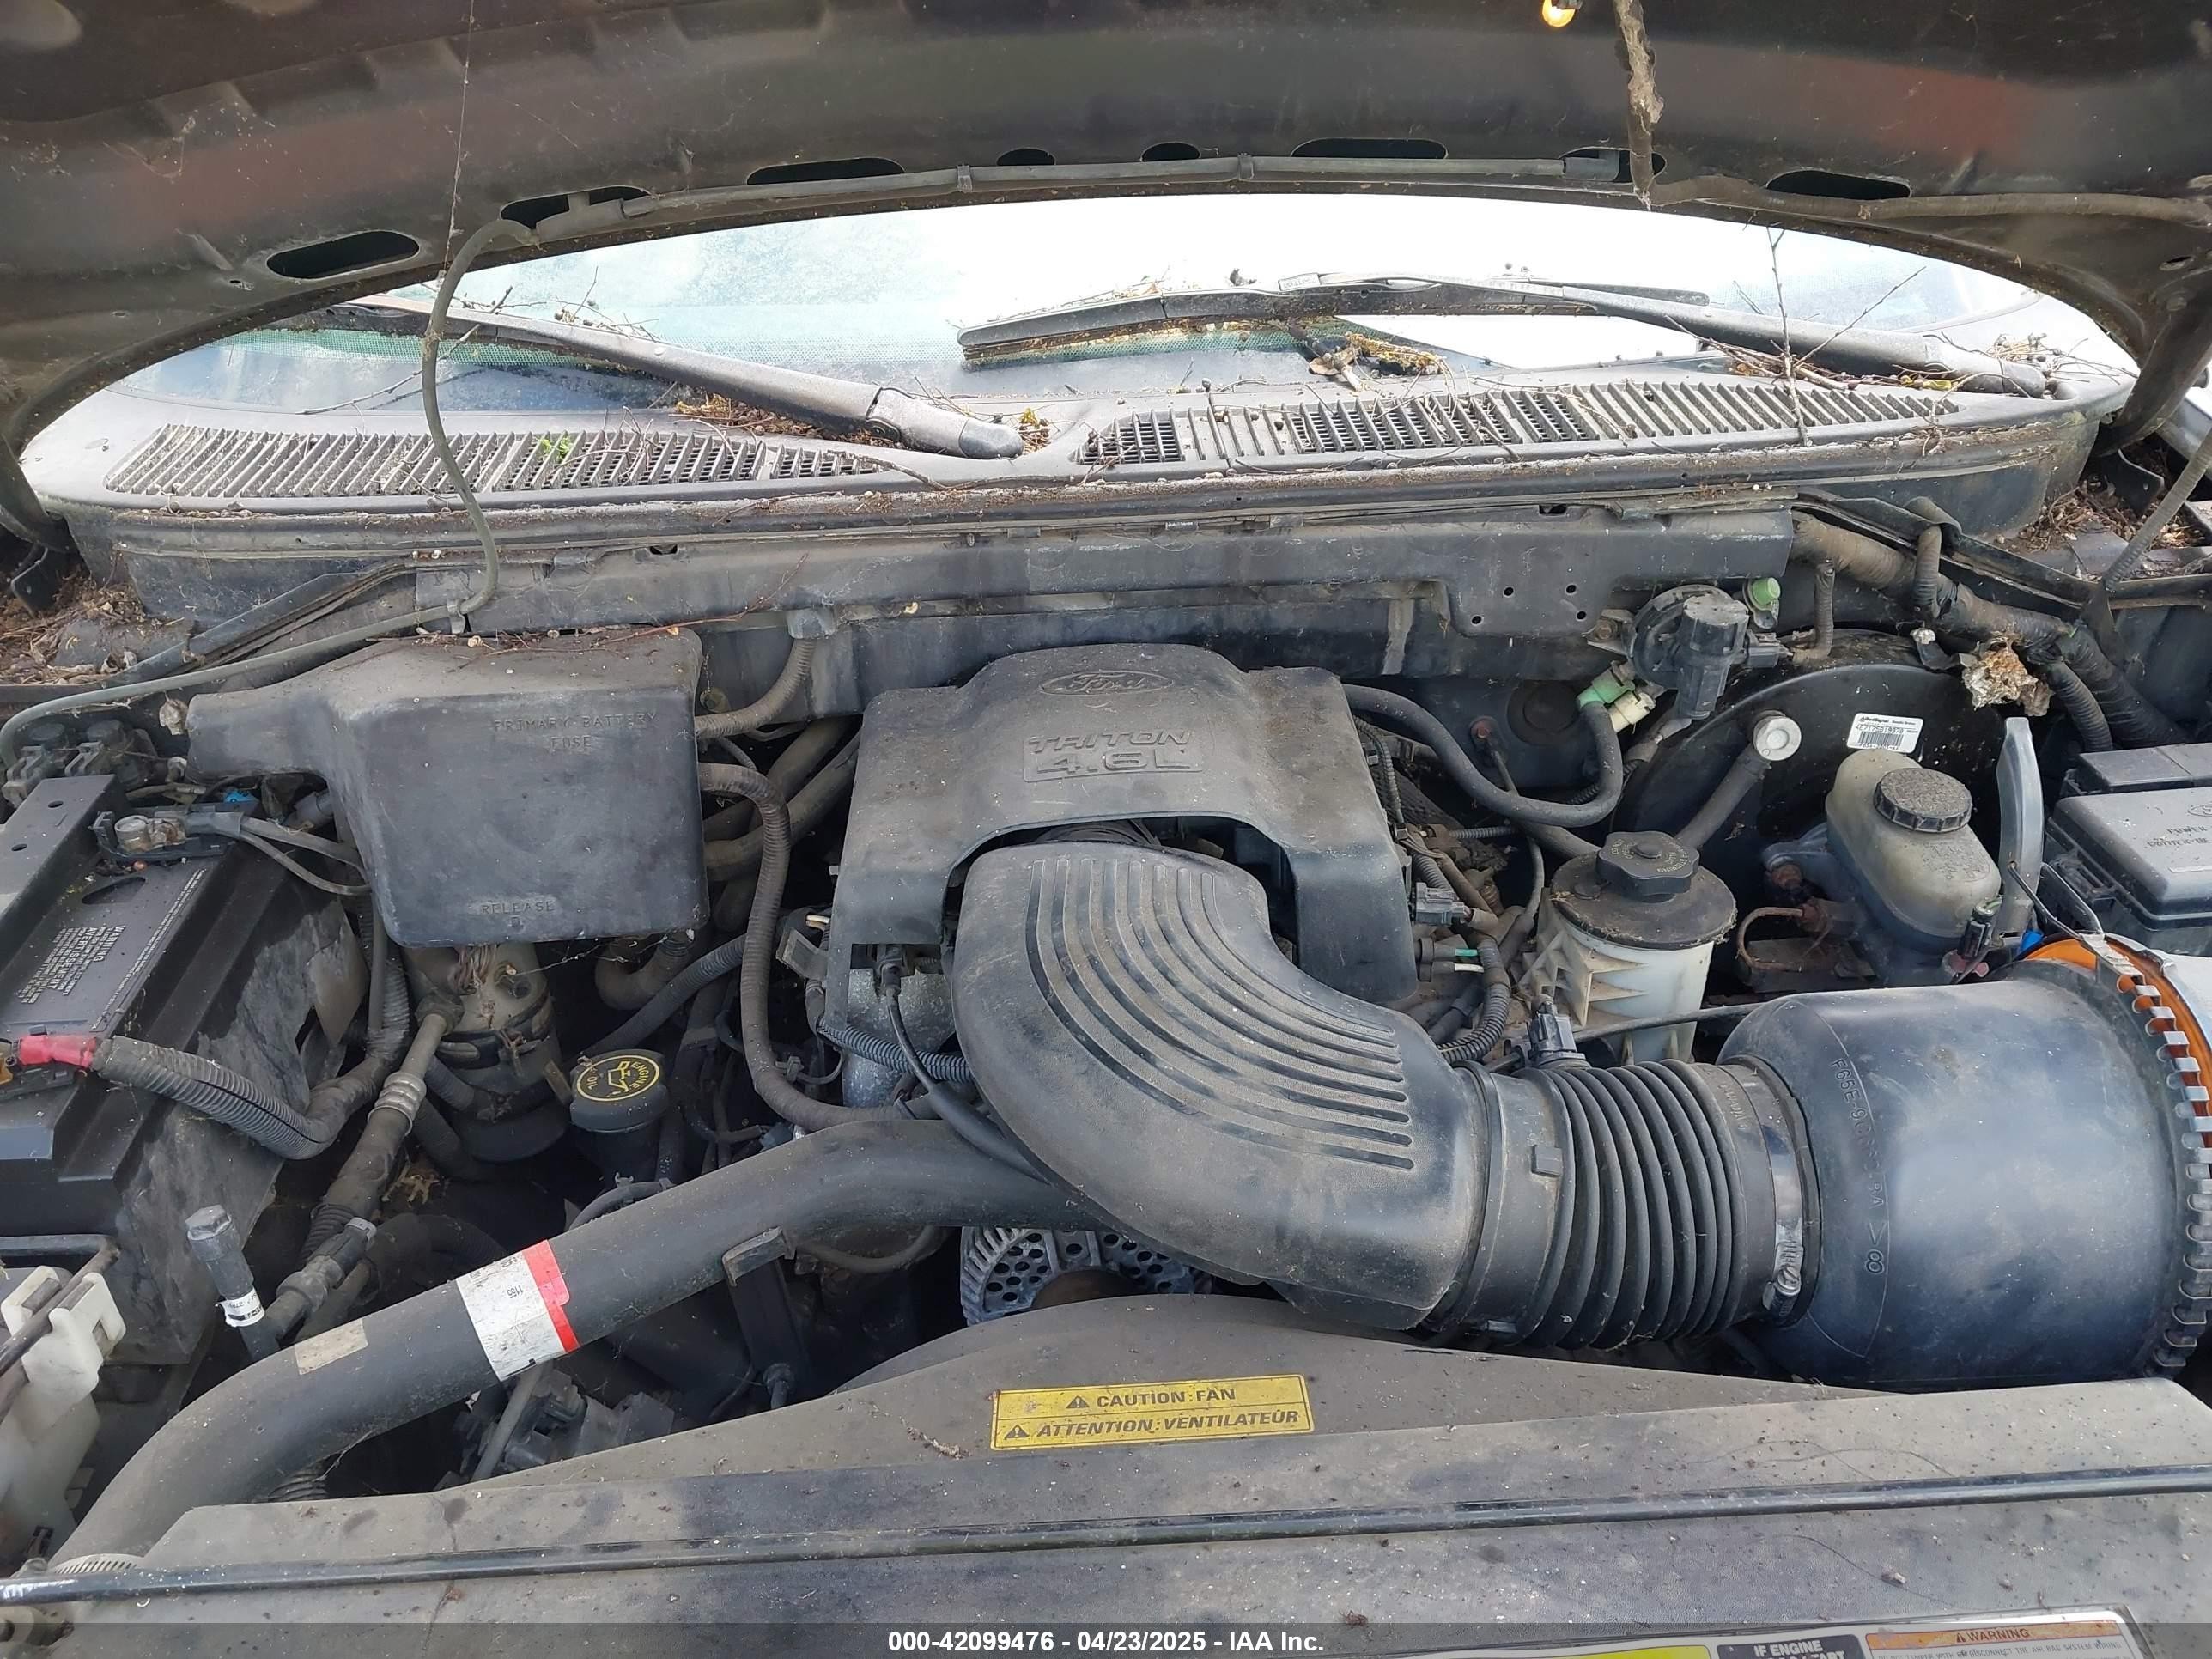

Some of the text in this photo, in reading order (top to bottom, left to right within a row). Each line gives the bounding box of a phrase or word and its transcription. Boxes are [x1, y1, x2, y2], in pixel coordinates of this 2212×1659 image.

[494, 713, 657, 731] PRIMARY BATTERY
[550, 734, 592, 749] FUSE
[1030, 730, 1191, 753] TRITON
[1037, 749, 1190, 774] 4.6L
[481, 900, 555, 915] RELEASE
[586, 1076, 599, 1091] OIL
[630, 1061, 650, 1089] ENGINE
[1164, 1410, 1299, 1431] VENTILATEUR
[1967, 1628, 2030, 1642] WARNING
[1753, 1639, 1823, 1657] IF ENGINE
